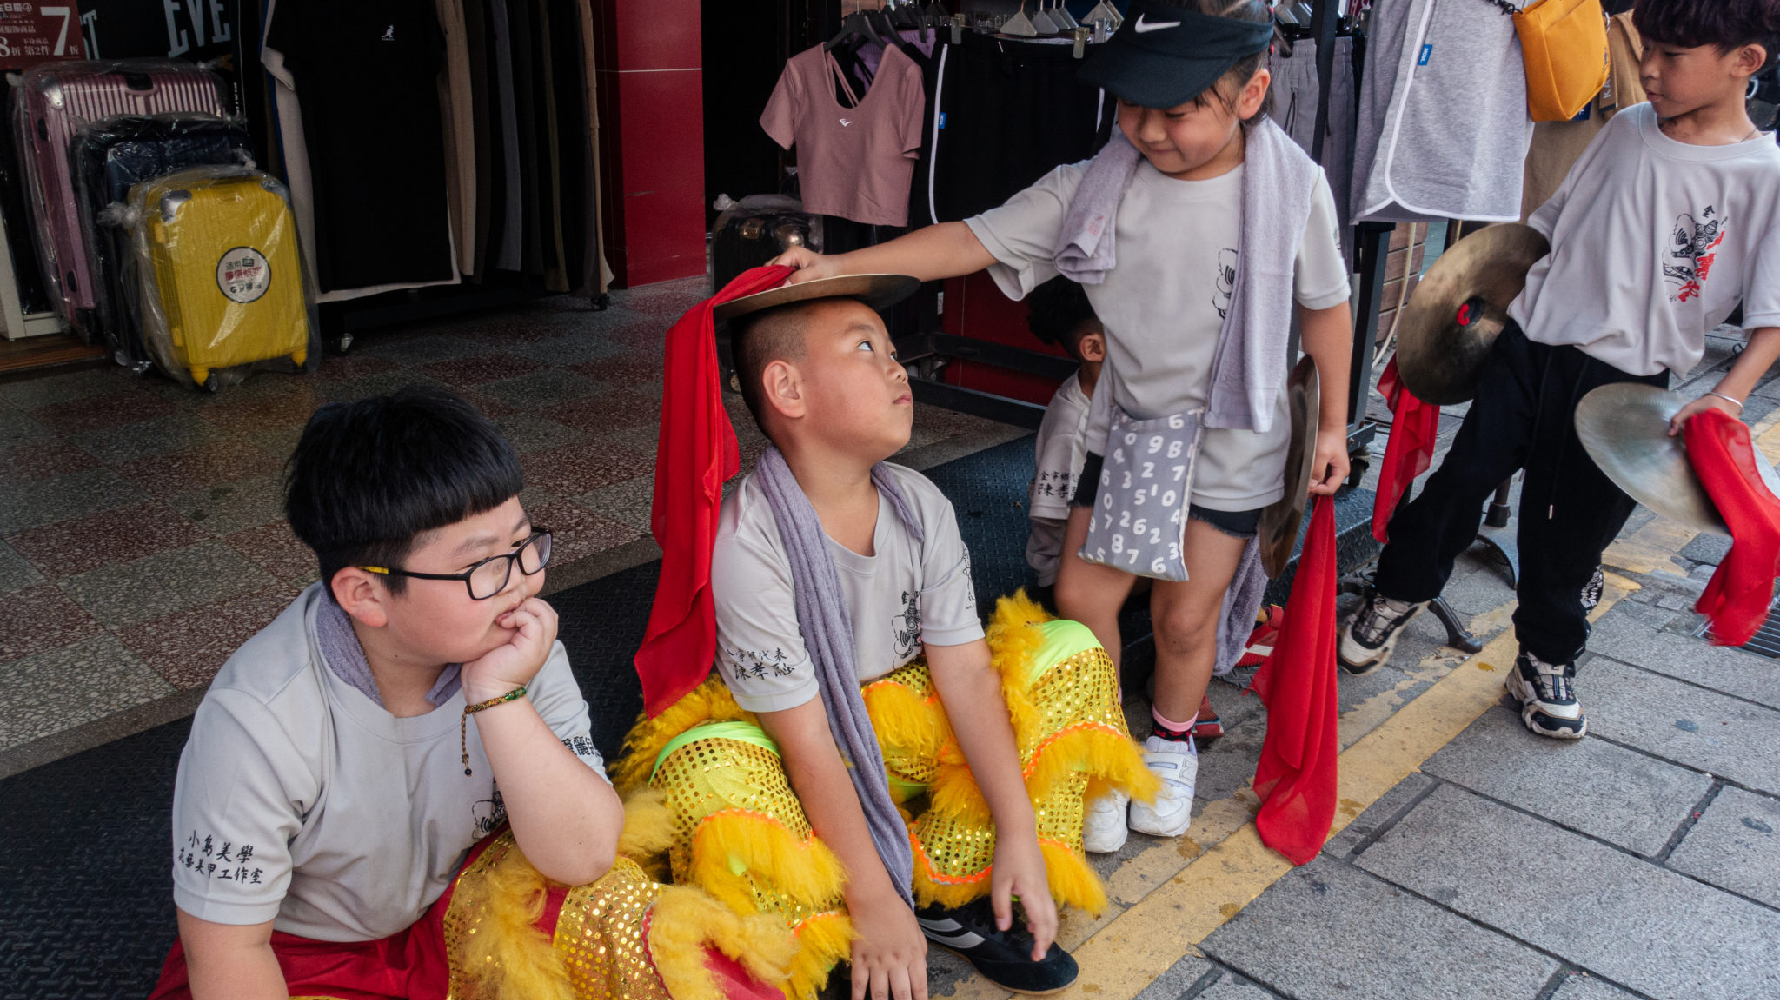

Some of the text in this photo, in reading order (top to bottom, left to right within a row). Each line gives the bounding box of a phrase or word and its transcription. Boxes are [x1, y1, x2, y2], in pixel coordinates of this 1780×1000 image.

[1169, 414, 1184, 429] 6
[1125, 433, 1137, 445] 0
[1148, 435, 1164, 454] 9
[1113, 448, 1125, 464] 4
[1167, 440, 1183, 458] 8
[1102, 468, 1111, 486] 6
[1141, 461, 1155, 478] 2
[1172, 465, 1185, 481] 7
[1122, 471, 1132, 489] 3
[1134, 489, 1147, 505] 5
[1151, 484, 1159, 496] 1
[1161, 490, 1176, 507] 0
[1104, 493, 1113, 510] 0
[1104, 513, 1113, 529] 7
[1119, 510, 1131, 527] 2
[1133, 518, 1147, 535] 6
[1112, 533, 1124, 554] 8
[1149, 528, 1160, 544] 2
[1126, 549, 1139, 564] 7
[1168, 542, 1179, 560] 3
[1152, 556, 1167, 574] 6
